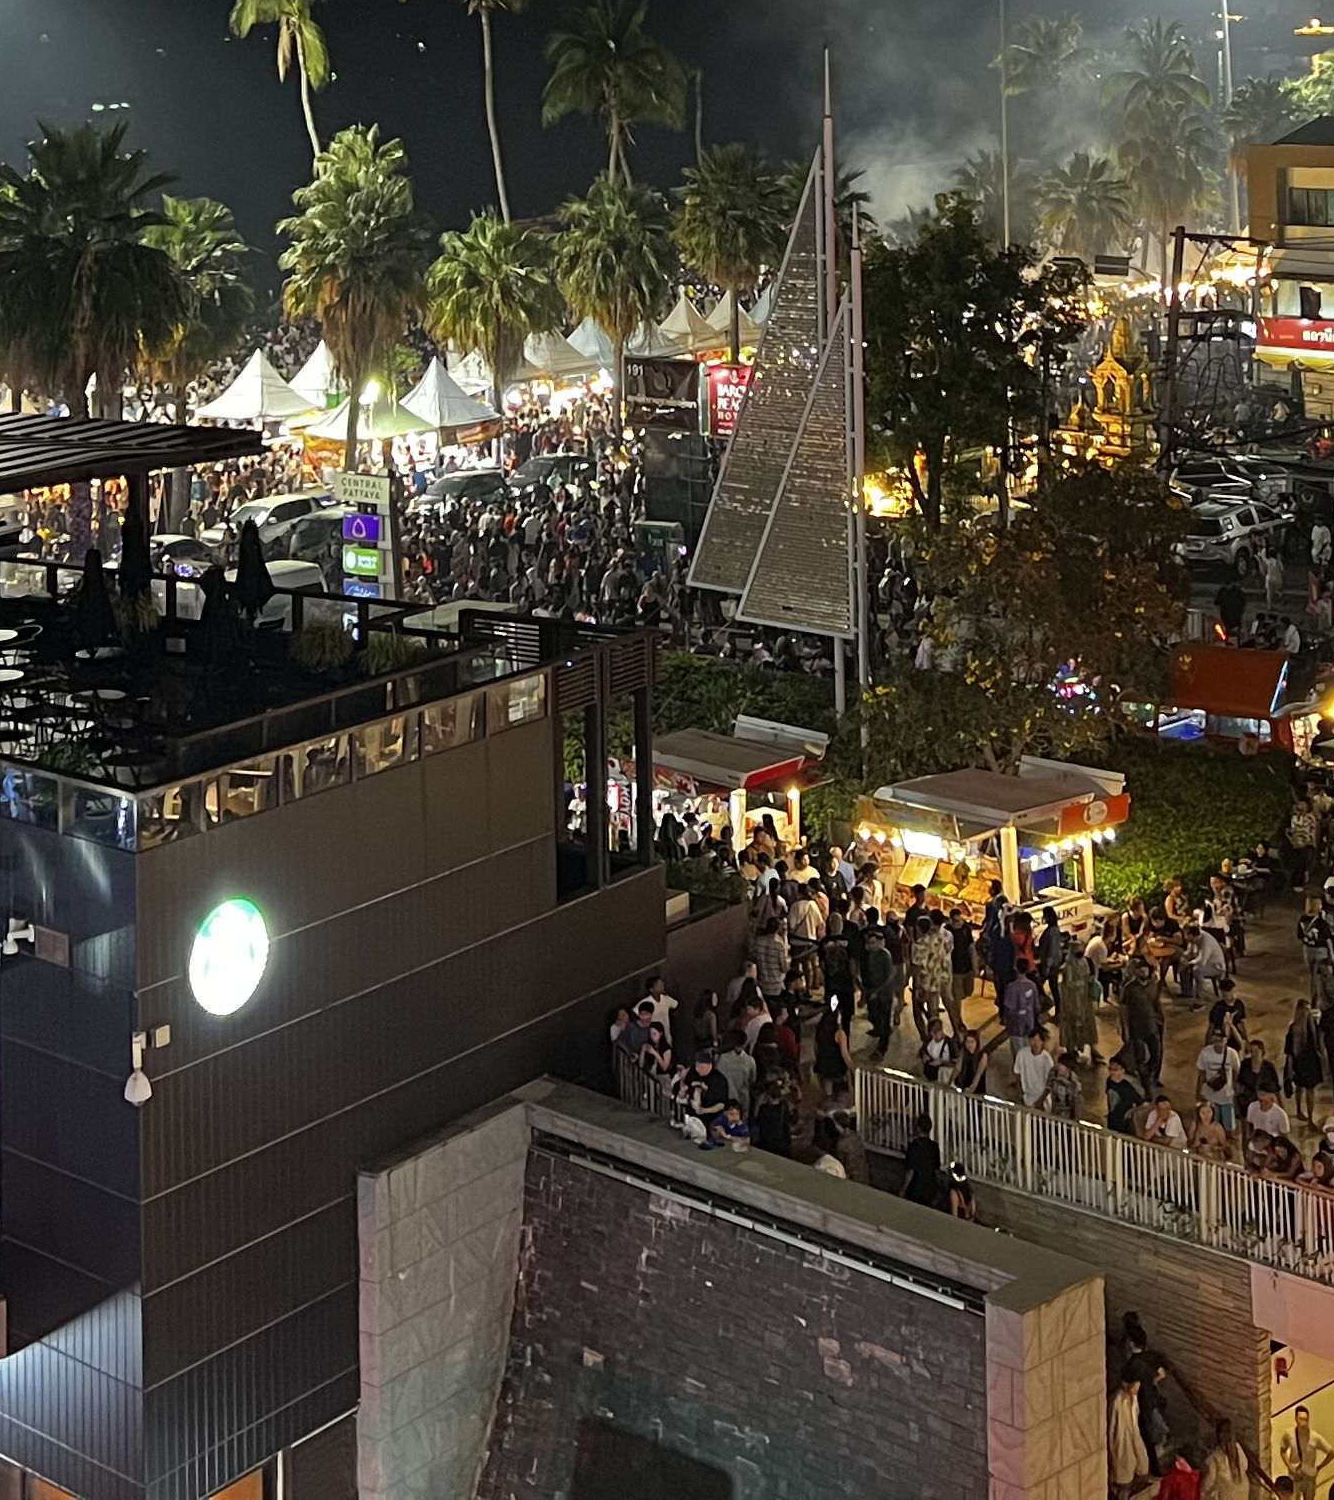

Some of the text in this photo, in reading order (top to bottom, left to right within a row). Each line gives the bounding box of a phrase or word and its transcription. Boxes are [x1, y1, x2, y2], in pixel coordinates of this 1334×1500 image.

[626, 363, 644, 377] 191
[717, 383, 747, 399] BARO
[717, 411, 739, 421] HOT
[341, 477, 383, 491] CENTRAL
[342, 488, 381, 500] PATTAYA
[1031, 905, 1079, 928] SUKI
